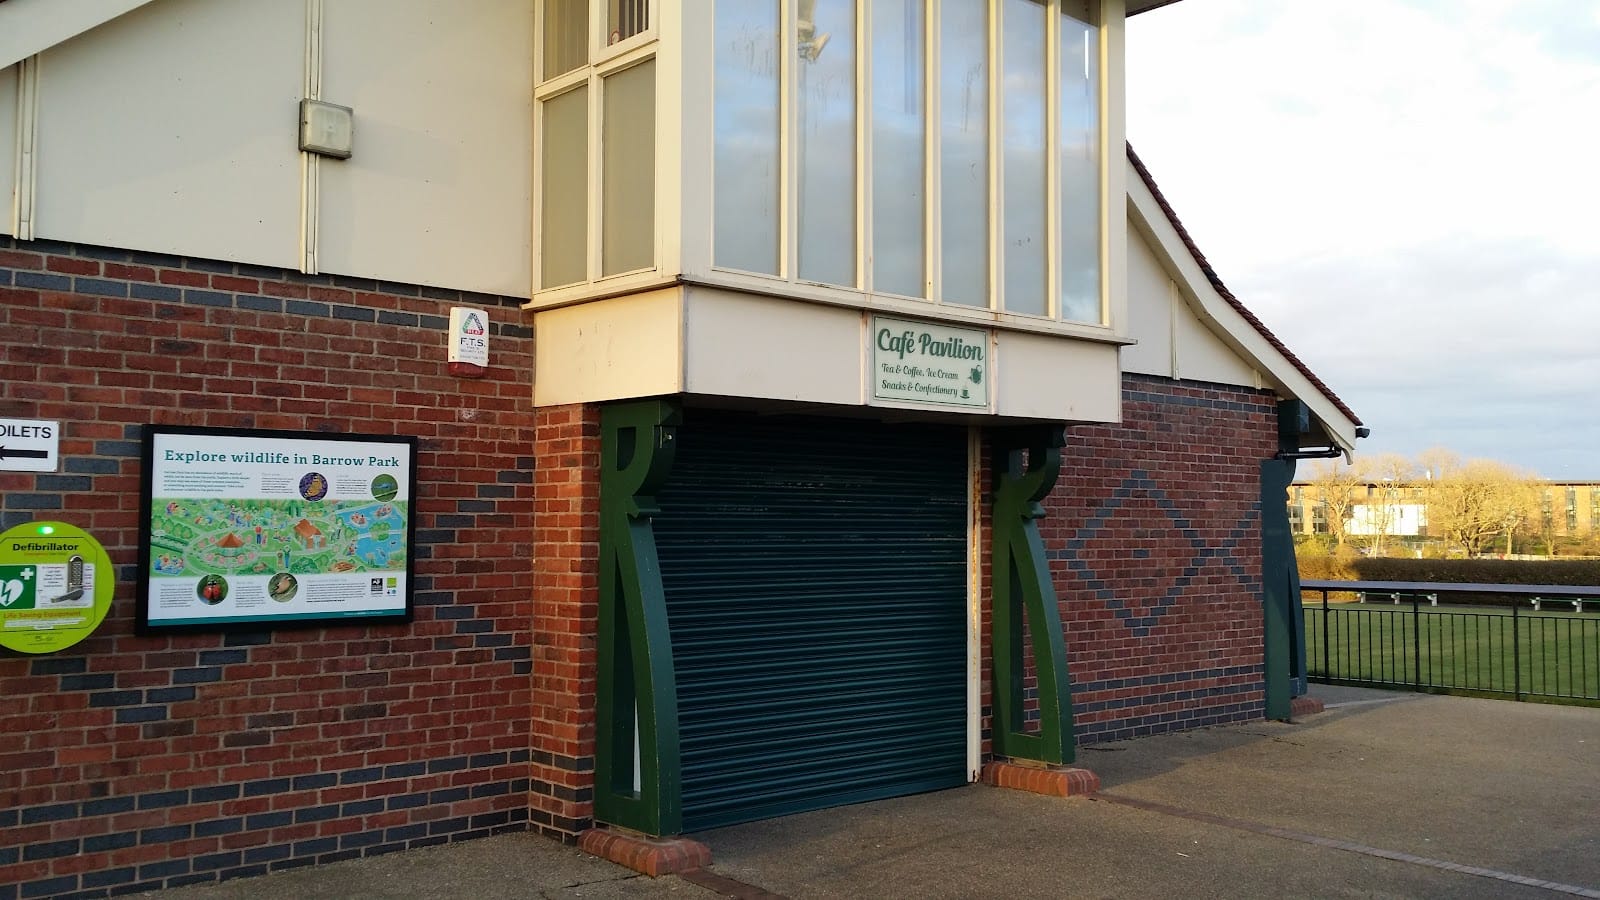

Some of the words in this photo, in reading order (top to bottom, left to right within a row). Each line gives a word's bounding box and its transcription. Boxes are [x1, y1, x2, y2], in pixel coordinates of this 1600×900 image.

[460, 337, 486, 347] F.T.S.
[877, 328, 915, 360] Café
[918, 333, 984, 361] Pavilion
[881, 363, 894, 373] Tea
[895, 365, 902, 374] &
[926, 368, 936, 378] Ice
[937, 369, 959, 380] Cream
[881, 380, 907, 390] Snacks
[907, 383, 914, 392] &
[914, 383, 958, 398] Confectionery
[0, 424, 52, 439] OILETS
[164, 449, 227, 464] Explore
[231, 451, 289, 464] wildlife
[294, 453, 308, 465] in
[312, 454, 365, 467] Barrow
[368, 456, 400, 467] Park
[12, 543, 79, 551] Defibrillator
